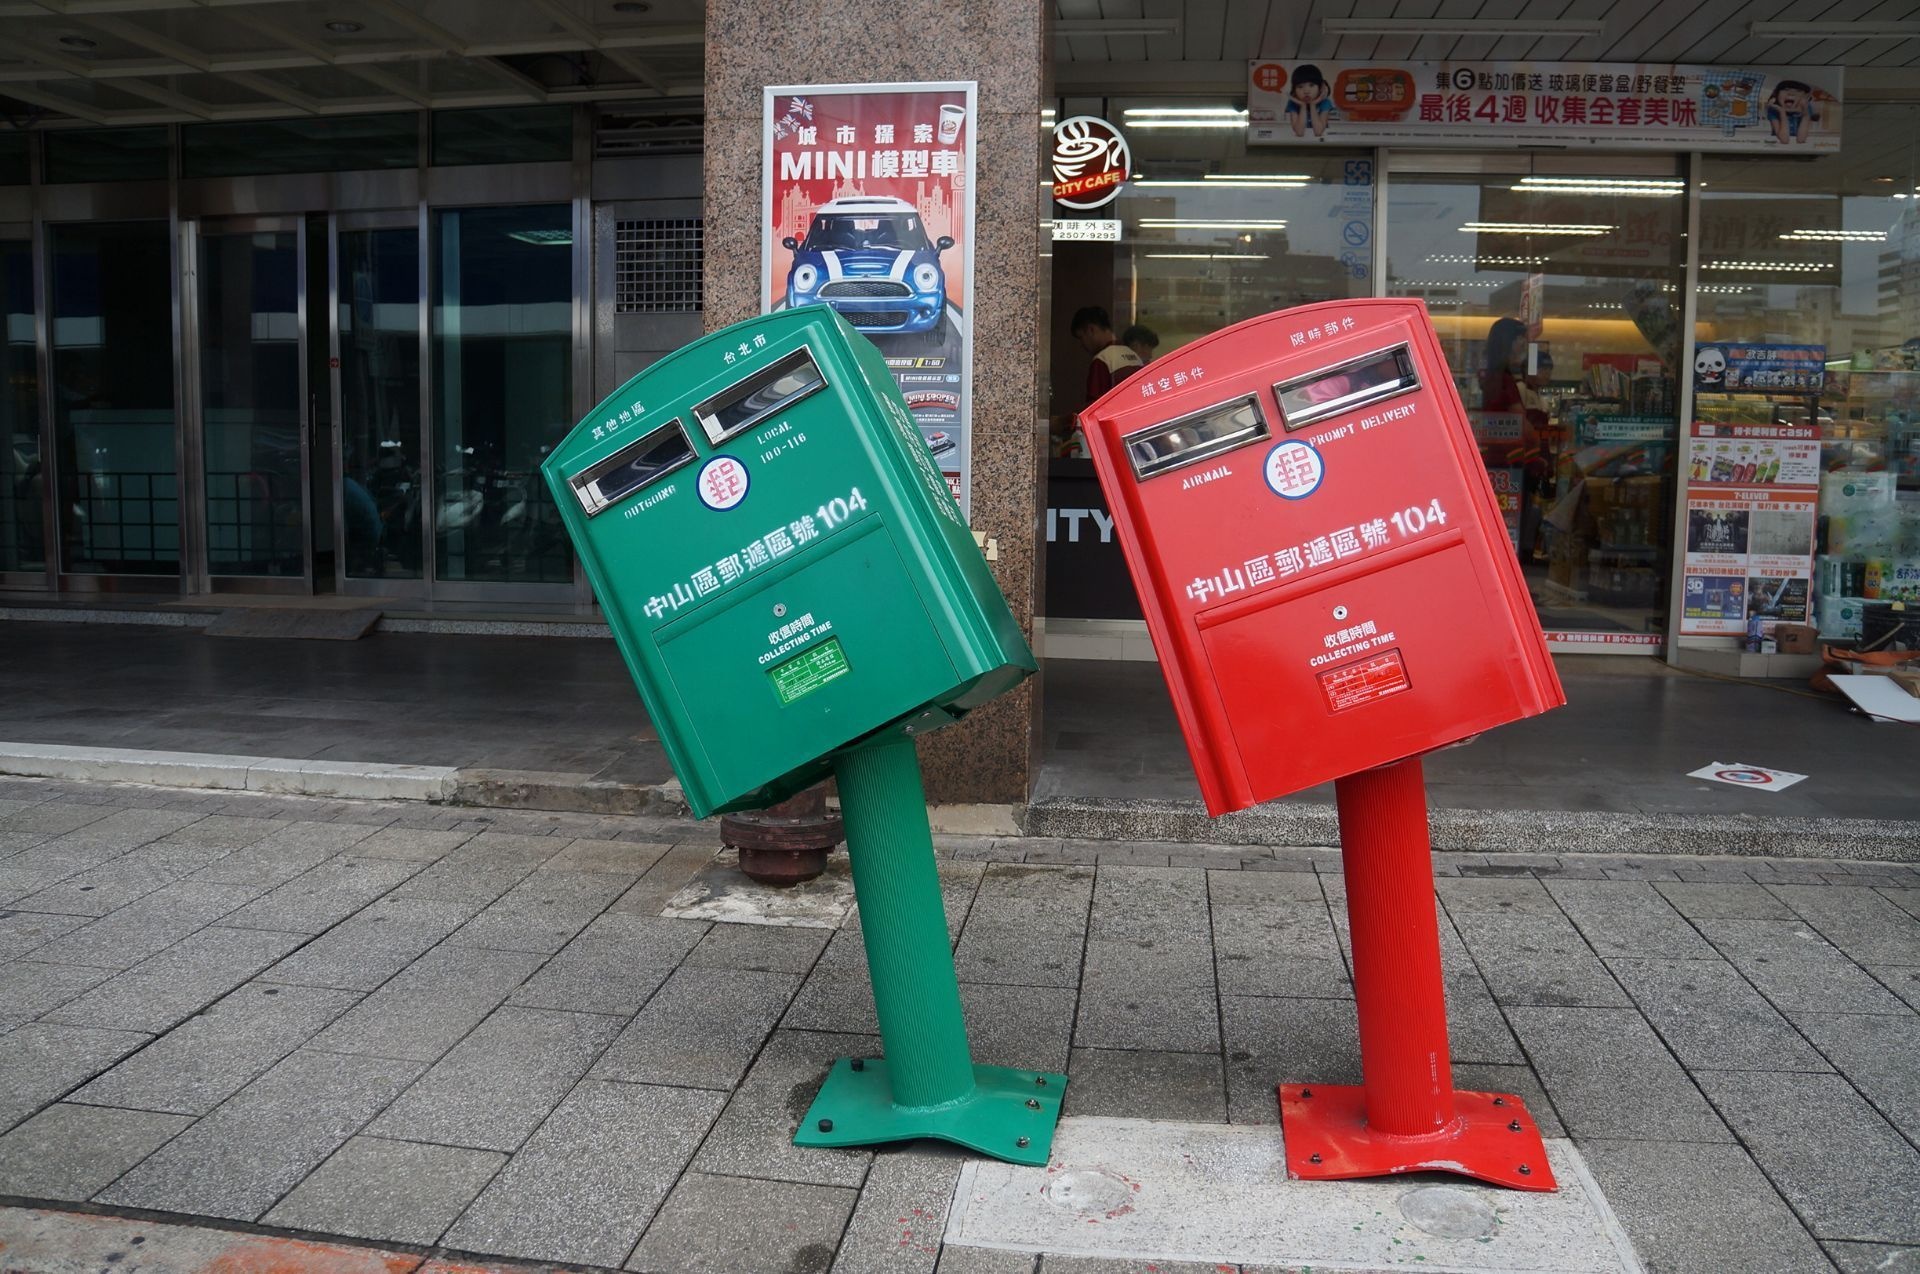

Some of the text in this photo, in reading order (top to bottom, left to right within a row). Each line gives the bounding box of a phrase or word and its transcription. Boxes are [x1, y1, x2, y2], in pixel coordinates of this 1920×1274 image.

[1419, 94, 1697, 127] 最後4週 收集全套美味
[797, 123, 933, 146] 城市探索
[1053, 171, 1121, 196] CITY CAFE
[1059, 232, 1116, 240] 2507-9295
[1289, 316, 1356, 347] 限時郵件
[723, 333, 767, 365] 台北市
[1141, 366, 1205, 398] 航空郵件
[591, 400, 645, 440] 其他地區
[756, 420, 793, 446] LOCAL
[1308, 403, 1417, 448] PROMPT DELIVERY
[760, 433, 807, 465] 100-116
[1181, 465, 1232, 490] AIRMAIL
[623, 484, 677, 520] OUTGOING
[758, 620, 833, 665] COLLECTING TIME
[768, 612, 815, 645] 收信時間
[1324, 620, 1377, 649] 收信時間
[1310, 631, 1396, 667] COLLECTING TIME
